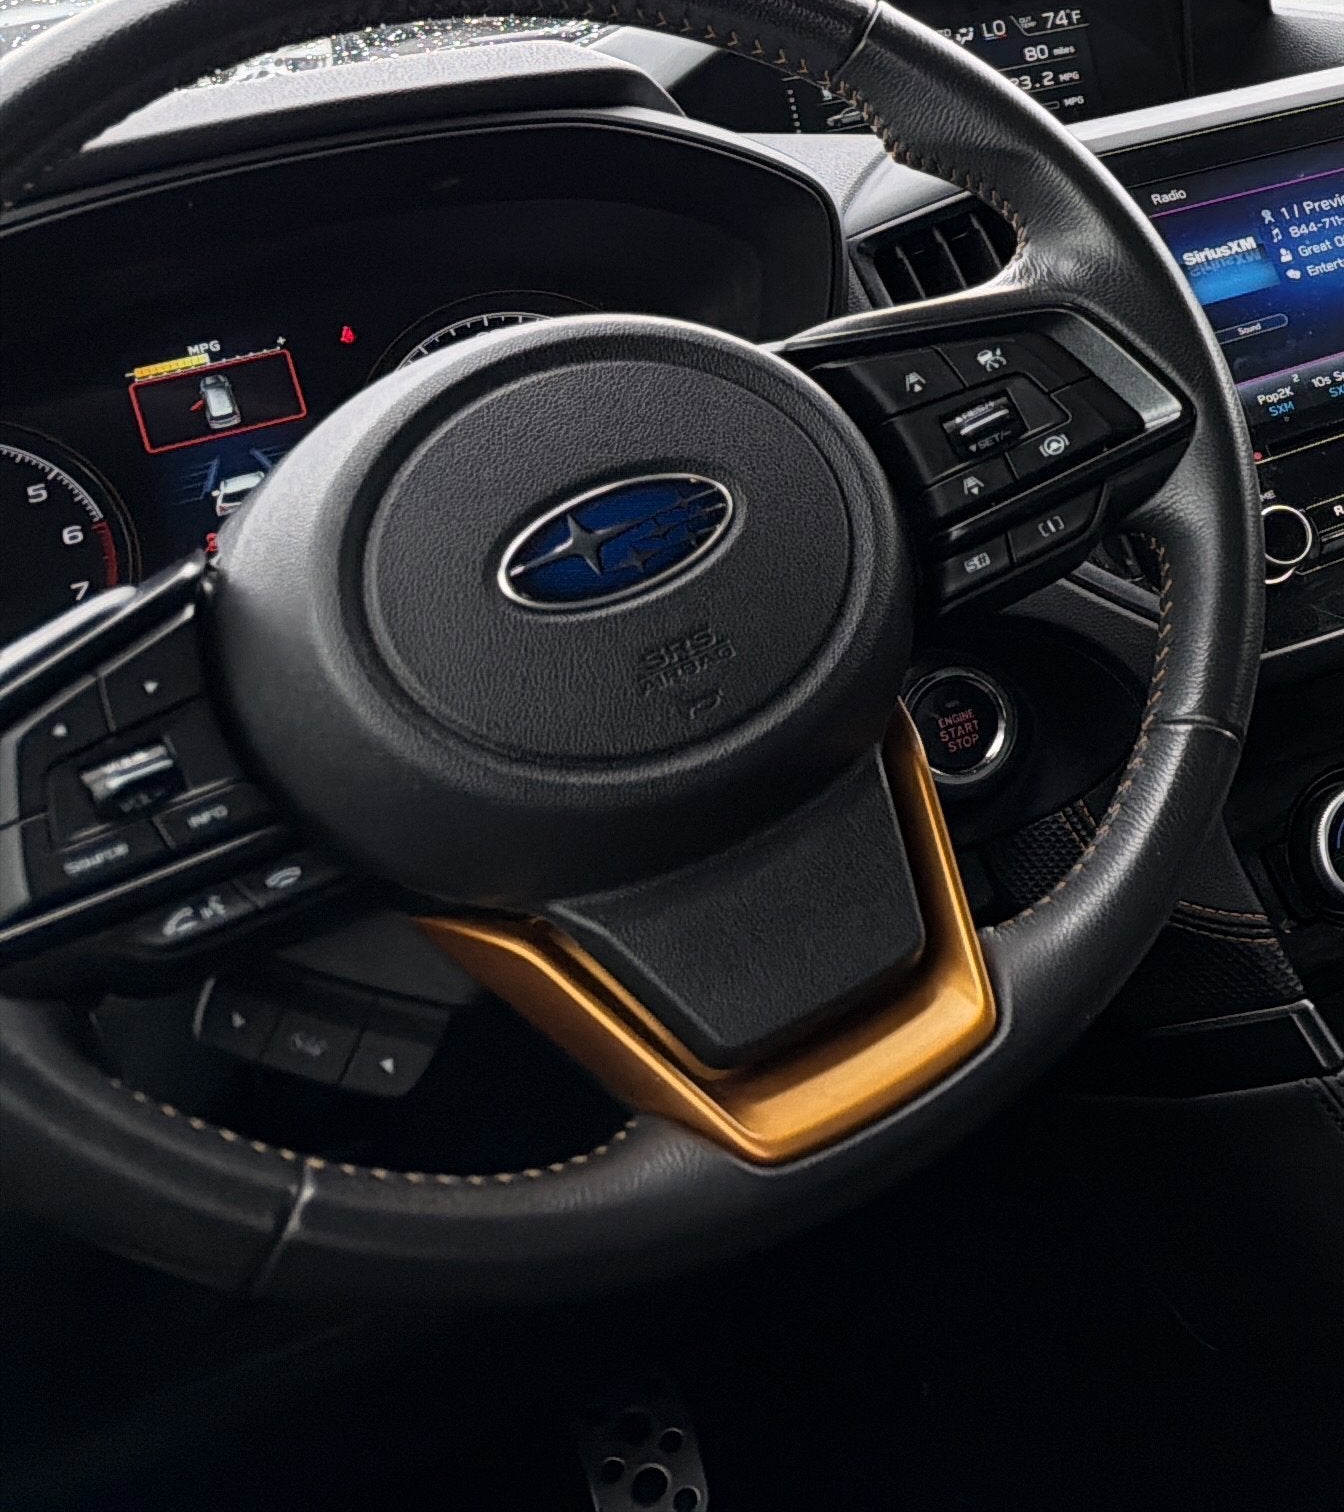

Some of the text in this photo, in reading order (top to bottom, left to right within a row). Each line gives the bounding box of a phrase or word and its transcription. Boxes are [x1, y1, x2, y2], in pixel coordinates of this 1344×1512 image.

[981, 19, 1006, 38] LO
[1023, 44, 1077, 62] 80 miles
[1058, 71, 1081, 83] MPG
[1063, 95, 1086, 108] MPG
[1150, 188, 1187, 206] Radio
[1281, 207, 1290, 221] 1
[1182, 235, 1258, 267] SiriusXM
[1298, 238, 1333, 258] Great
[1237, 322, 1262, 336] Sound
[187, 339, 221, 357] MPG
[1291, 373, 1300, 383] 2
[1311, 375, 1332, 388] 10s
[1256, 386, 1295, 406] Pop2K
[1268, 400, 1296, 418] SXM
[27, 484, 49, 504] 5
[62, 525, 85, 546] 6
[70, 580, 90, 602] 7
[938, 708, 975, 728] ENGINE
[940, 719, 979, 742] START
[948, 733, 980, 753] STOP
